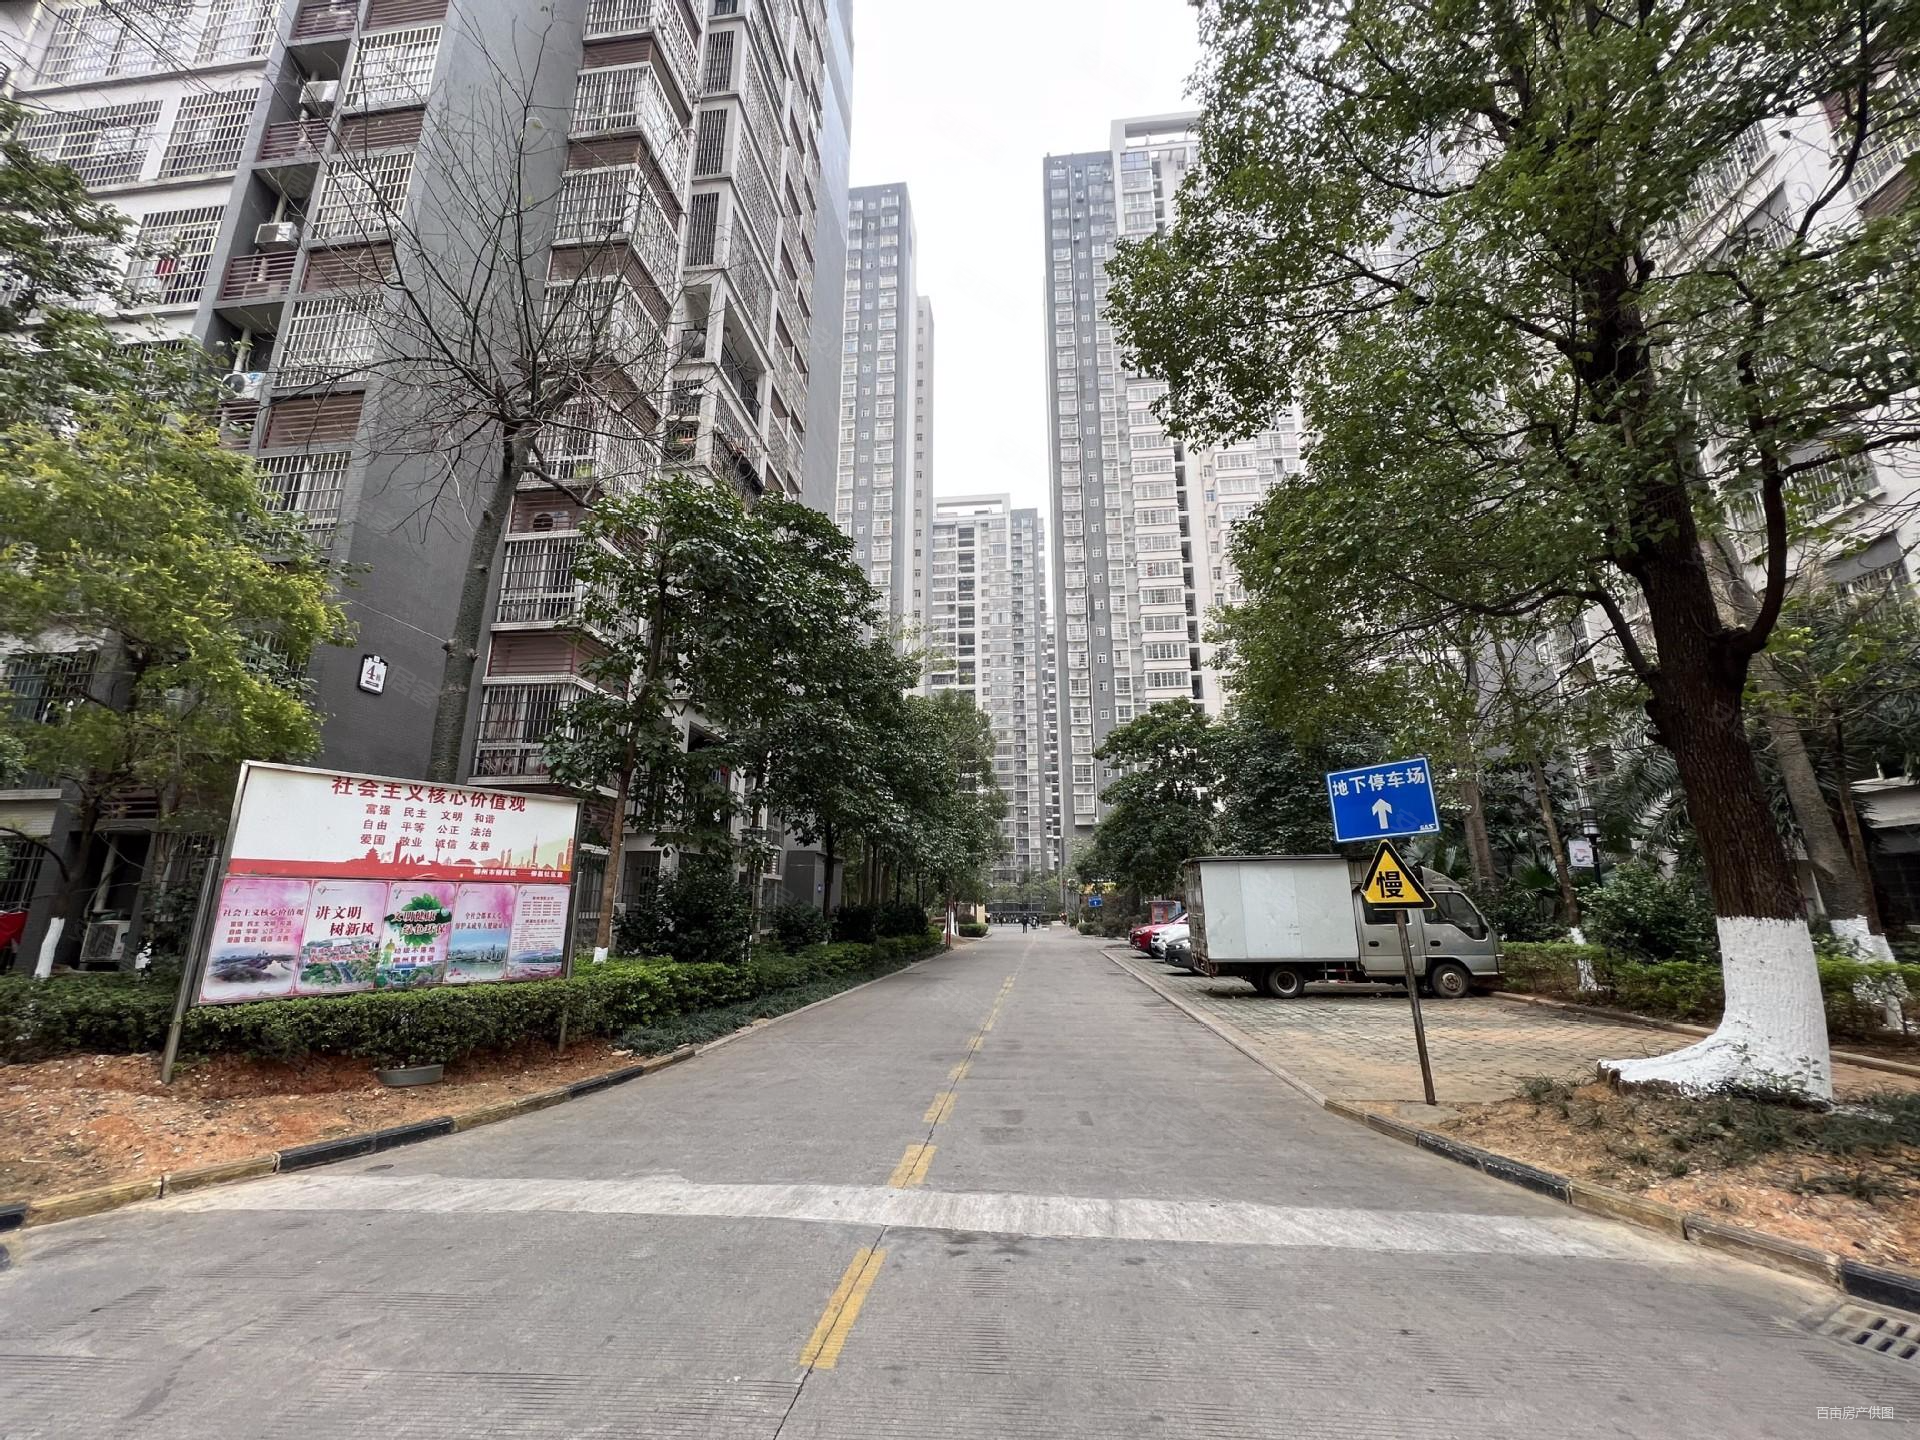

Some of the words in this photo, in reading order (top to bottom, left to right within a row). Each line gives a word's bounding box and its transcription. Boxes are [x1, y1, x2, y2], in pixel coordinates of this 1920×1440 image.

[1332, 766, 1426, 796] 地下停车场
[331, 776, 526, 812] 社会主义核心价值观
[365, 803, 391, 816] 富强
[403, 807, 428, 819] 民主
[440, 810, 463, 822] 文明
[474, 813, 496, 824] 和谐
[362, 819, 387, 831] 自由
[400, 822, 425, 833] 平等
[437, 824, 460, 835] 公正
[470, 826, 492, 838] 法治
[360, 834, 386, 846] 爱国
[398, 836, 423, 847] 敬业
[435, 838, 458, 850] 诚信
[469, 840, 490, 851] 友善
[1376, 870, 1404, 898] 慢
[315, 905, 362, 920] 讲文明
[394, 911, 436, 921] 文明健康
[330, 922, 374, 936] 树新风
